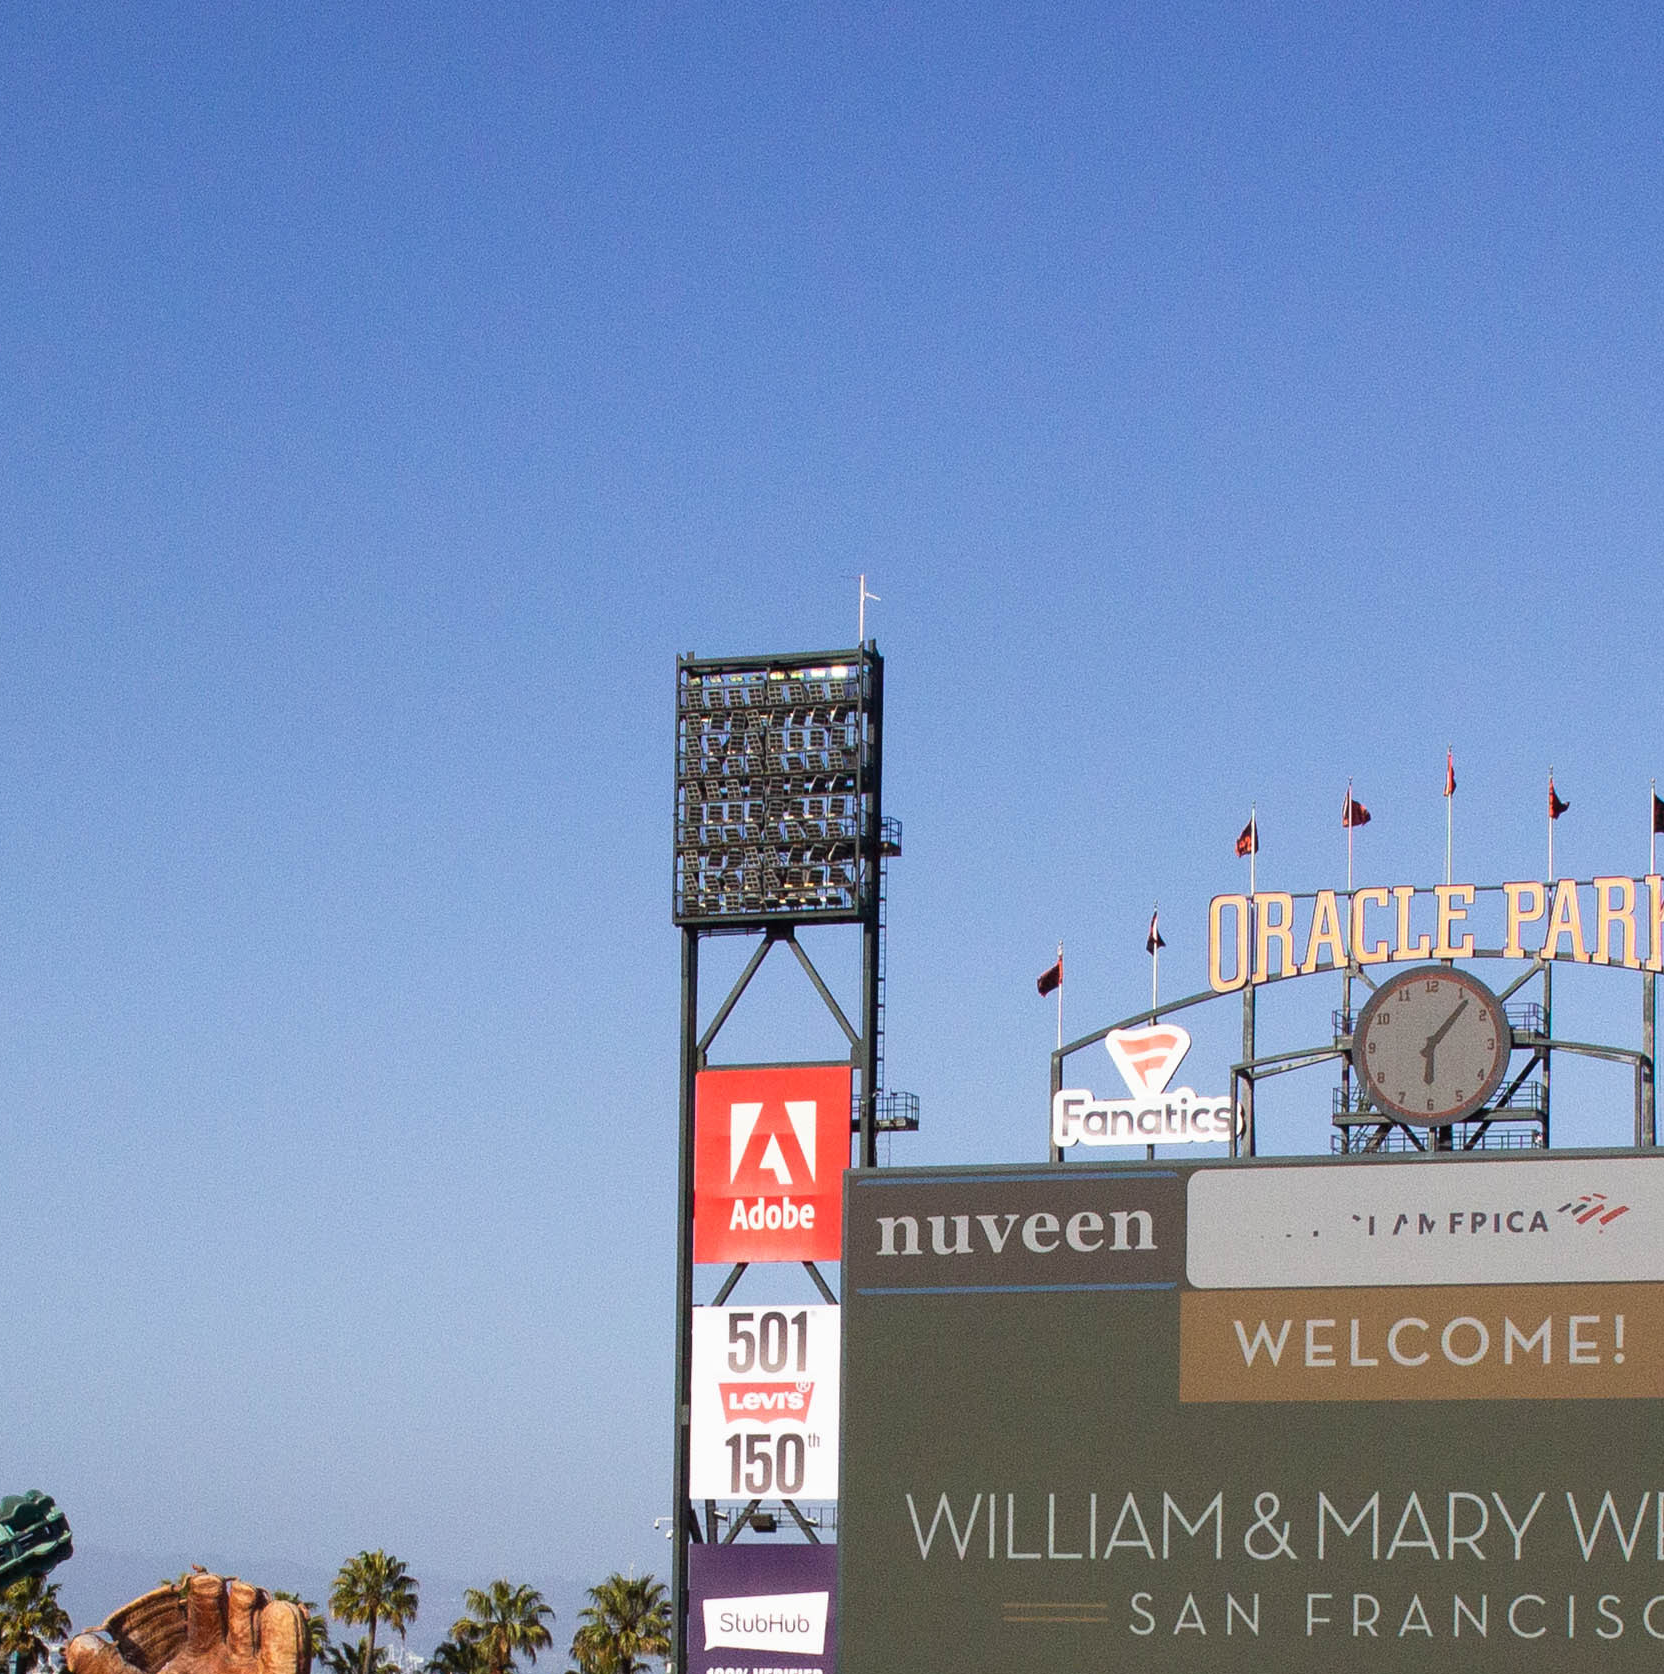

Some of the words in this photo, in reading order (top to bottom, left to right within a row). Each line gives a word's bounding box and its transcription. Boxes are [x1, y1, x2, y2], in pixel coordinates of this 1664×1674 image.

[1208, 884, 1474, 993] ORACLE
[1425, 981, 1439, 992] 12
[1398, 990, 1410, 1001] 11
[1458, 988, 1463, 999] 1
[1377, 1013, 1390, 1025] 10
[1479, 1010, 1486, 1021] 2
[1368, 1042, 1375, 1054] 9
[1487, 1039, 1494, 1050] 3
[1377, 1072, 1385, 1083] 8
[1477, 1069, 1484, 1080] 4
[1398, 1092, 1406, 1104] 7
[1455, 1090, 1463, 1101] 5
[1427, 1099, 1433, 1110] 6
[1062, 1094, 1232, 1135] Fanatics
[729, 1197, 815, 1231] Adobe
[877, 1209, 1158, 1256] nuveen
[727, 1311, 807, 1374] 501
[1234, 1314, 1628, 1370] WELCOME!
[906, 1491, 1224, 1561] WILLIAM
[1243, 1492, 1298, 1561] &
[1318, 1491, 1545, 1561] MARY
[1128, 1591, 1261, 1637] SAN
[719, 1612, 810, 1634] StubHub
